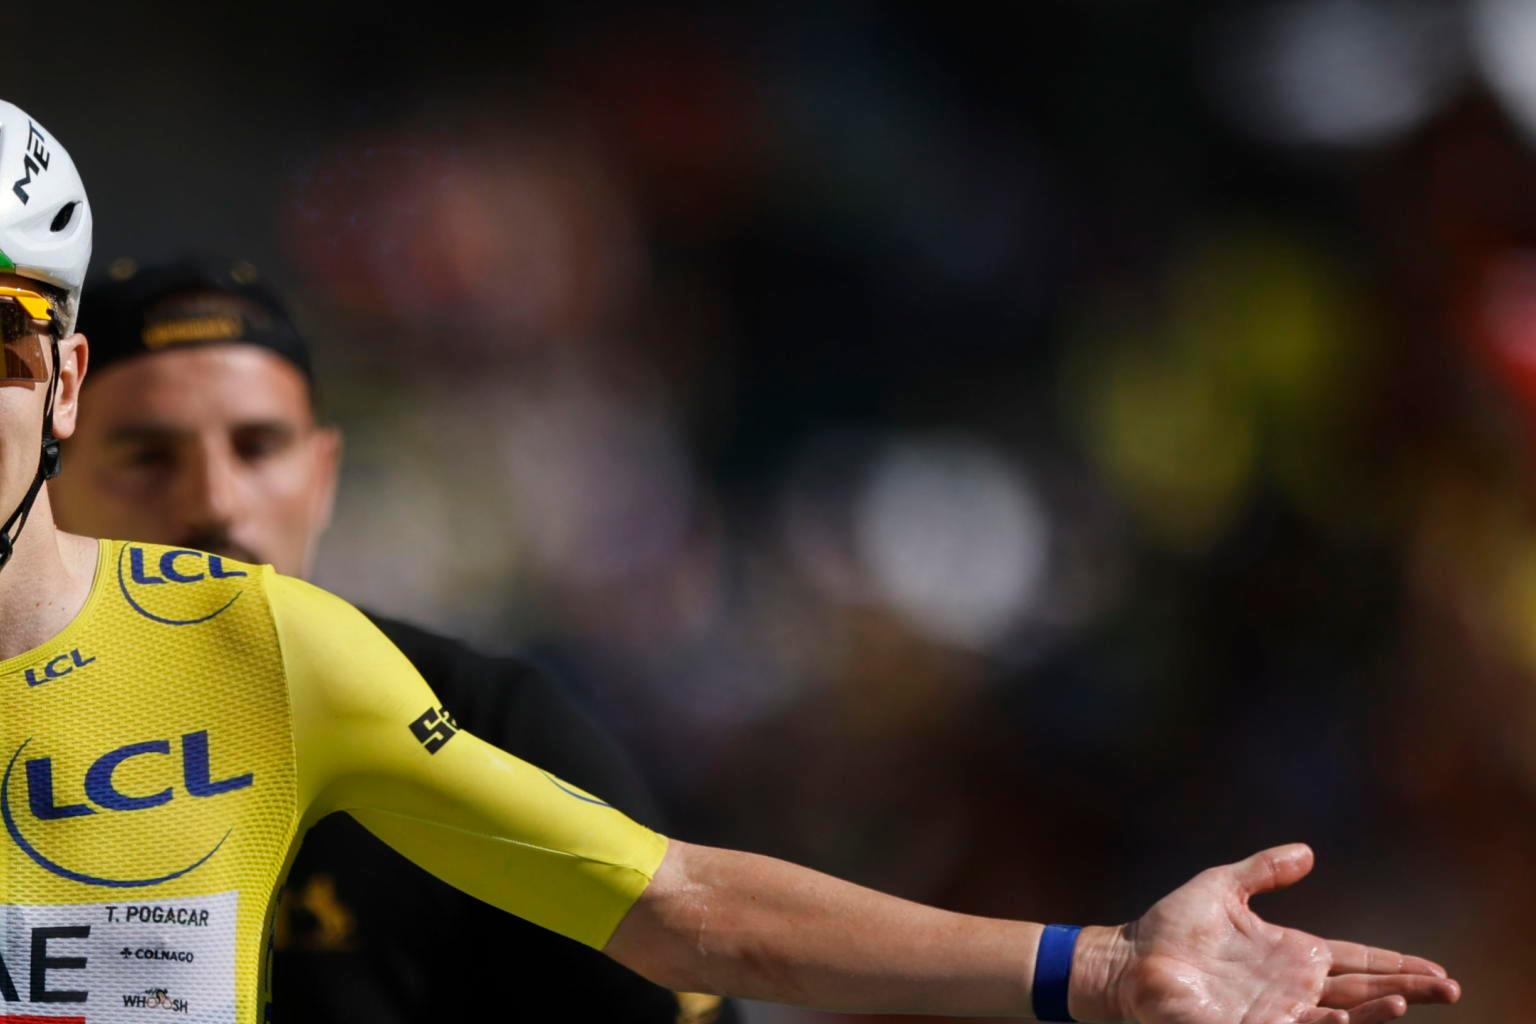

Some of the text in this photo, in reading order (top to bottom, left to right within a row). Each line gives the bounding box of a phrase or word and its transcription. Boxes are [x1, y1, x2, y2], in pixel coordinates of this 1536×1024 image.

[13, 119, 50, 206] MET
[127, 546, 248, 585] LCL
[24, 648, 96, 687] LCL
[25, 729, 254, 821] LCL
[105, 906, 210, 927] T. POGACAR
[134, 948, 195, 964] COLNAGO
